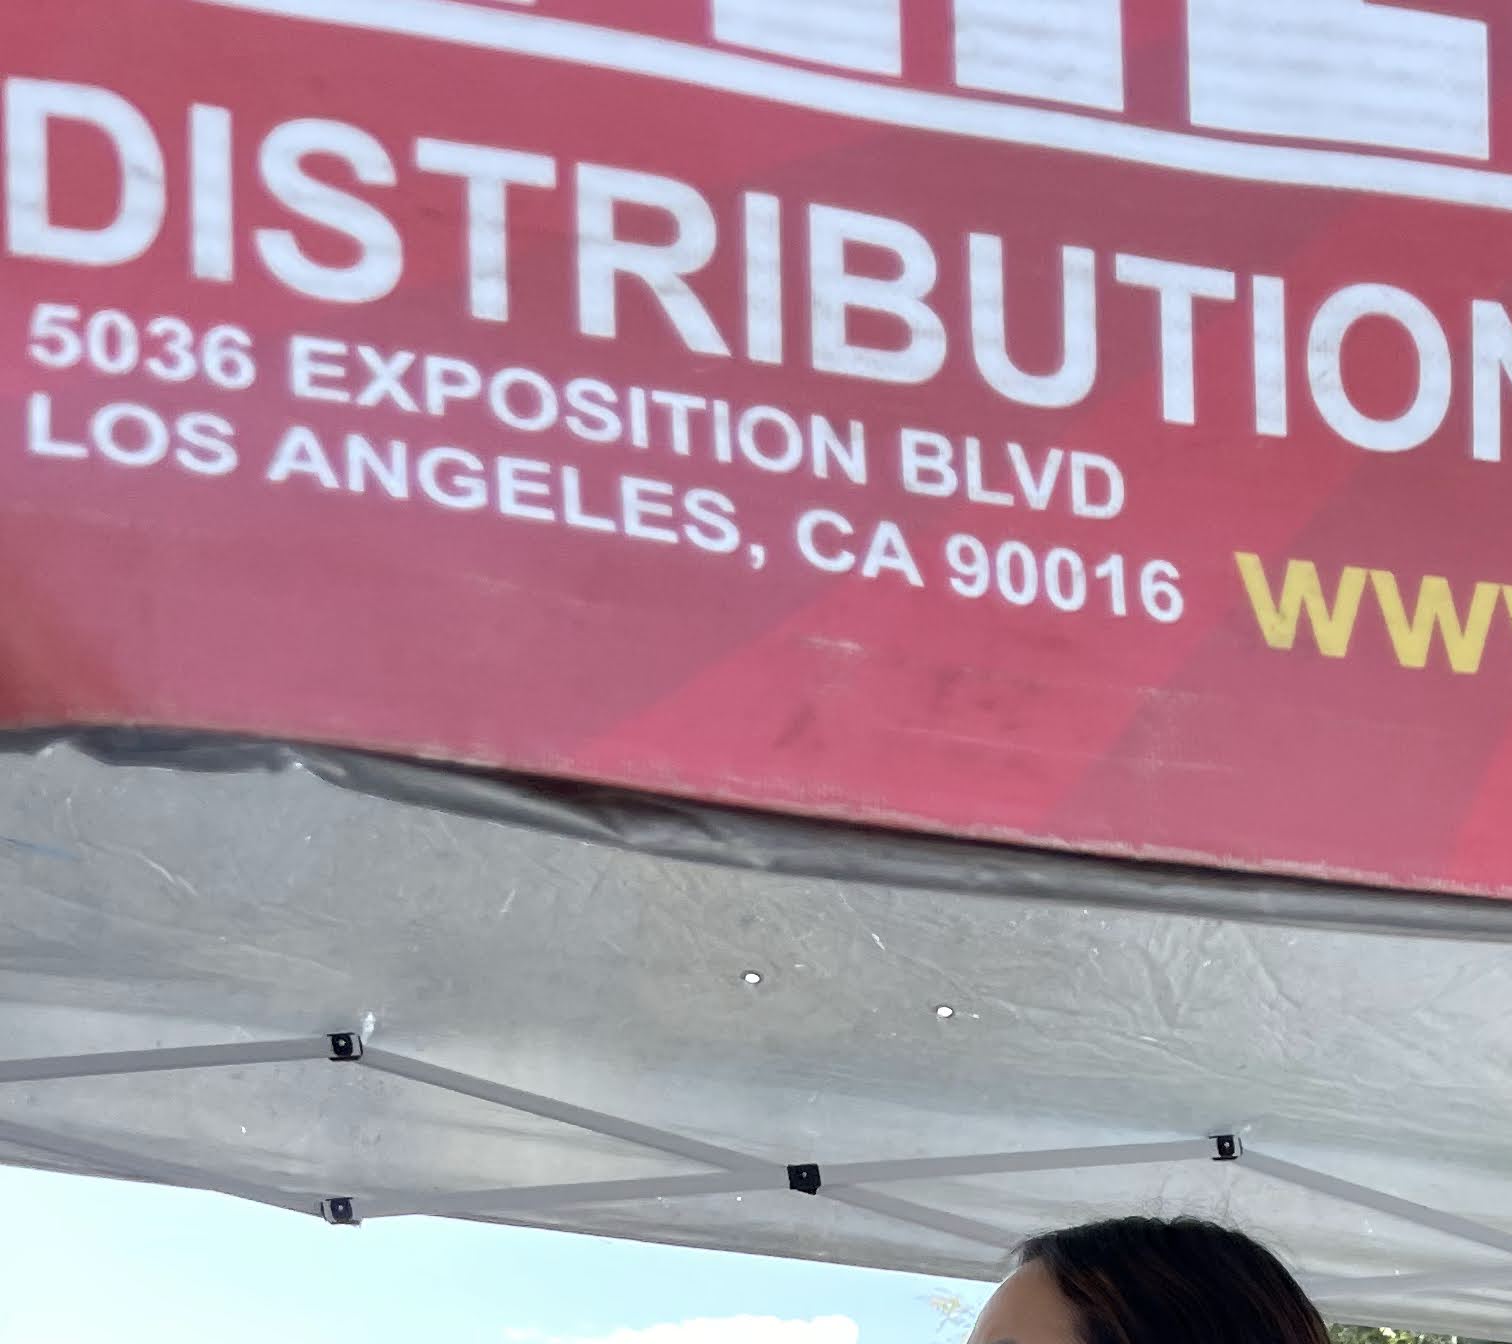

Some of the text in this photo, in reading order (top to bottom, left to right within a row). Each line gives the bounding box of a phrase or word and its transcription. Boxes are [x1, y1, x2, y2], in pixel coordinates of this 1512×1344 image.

[27, 304, 1126, 521] 5036 EXPOSITION BLVD
[27, 393, 1185, 624] LOS ANGELES, CA 90016
